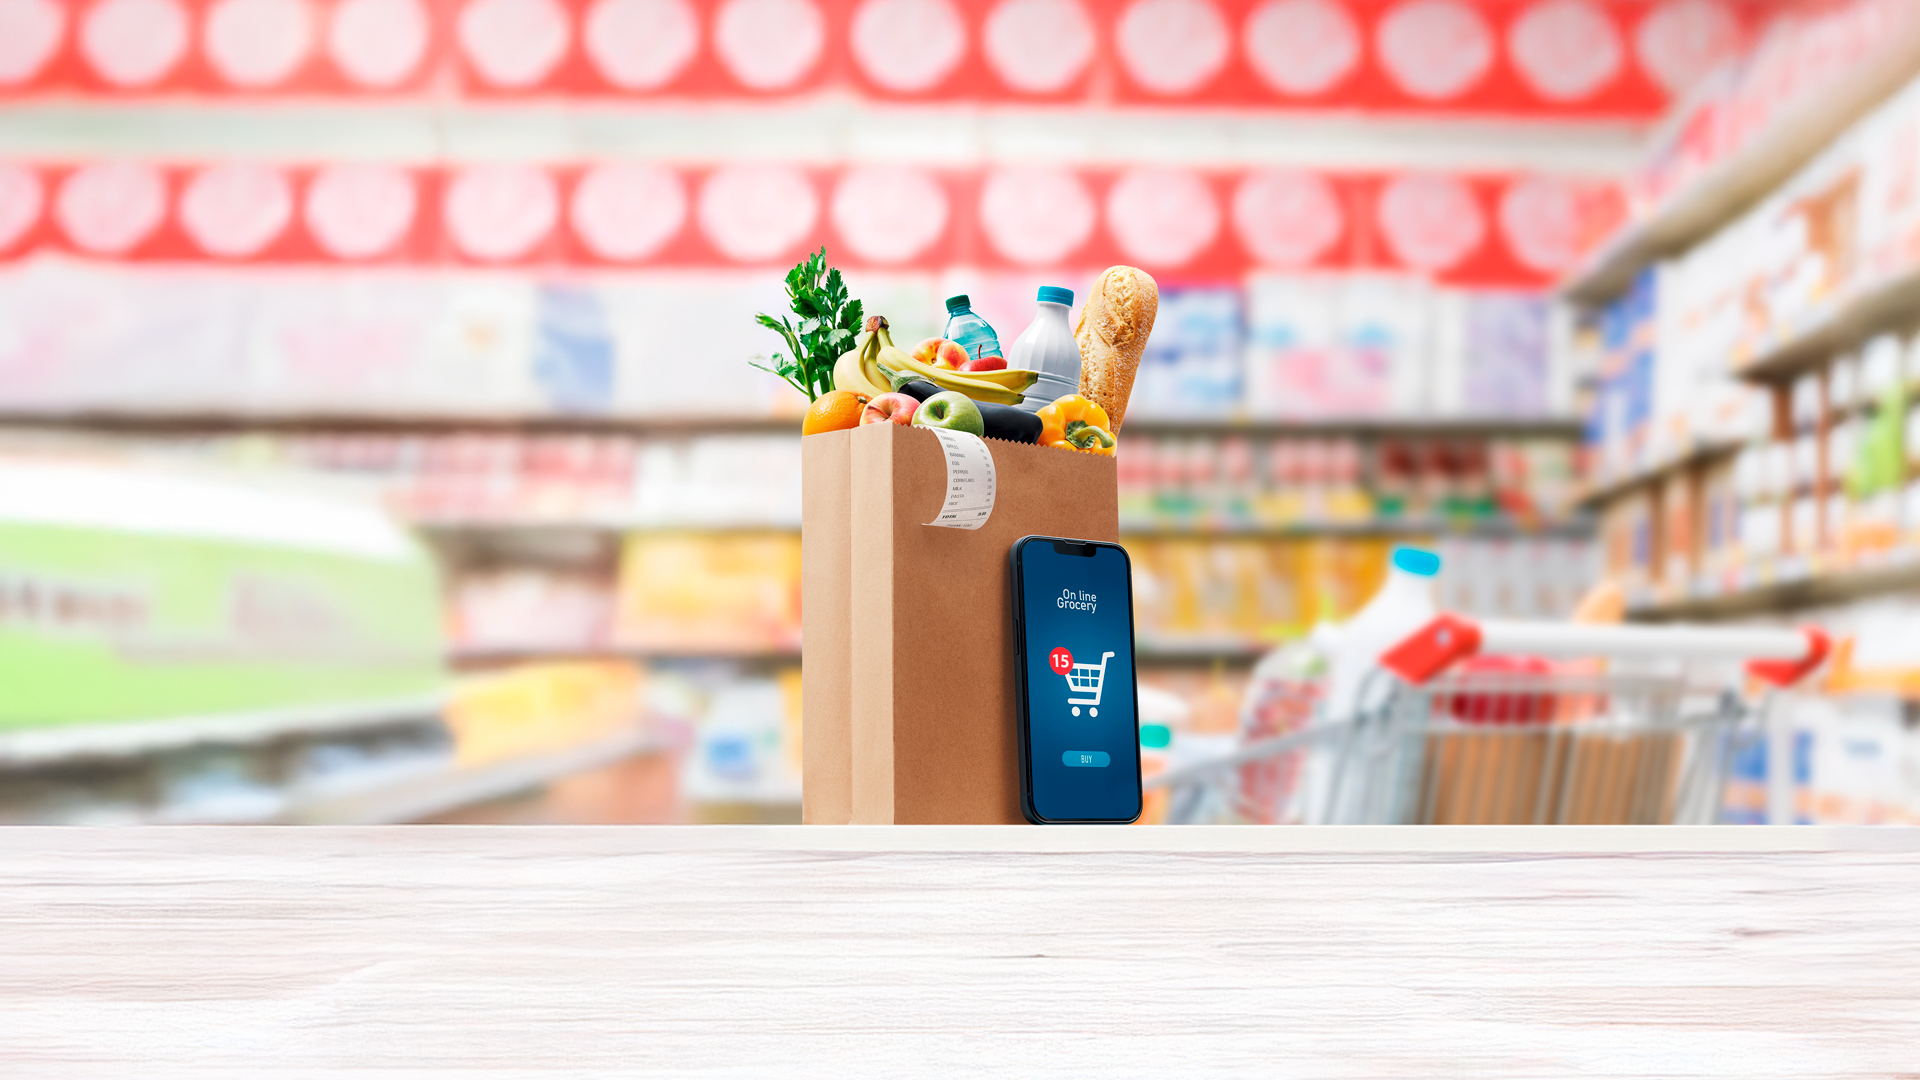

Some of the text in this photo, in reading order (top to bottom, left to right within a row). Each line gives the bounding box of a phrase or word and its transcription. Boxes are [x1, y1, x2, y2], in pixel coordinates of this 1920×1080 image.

[1062, 588, 1097, 603] On line
[1056, 596, 1097, 615] Grocery
[1052, 653, 1070, 669] 15
[1080, 754, 1093, 764] BUY
